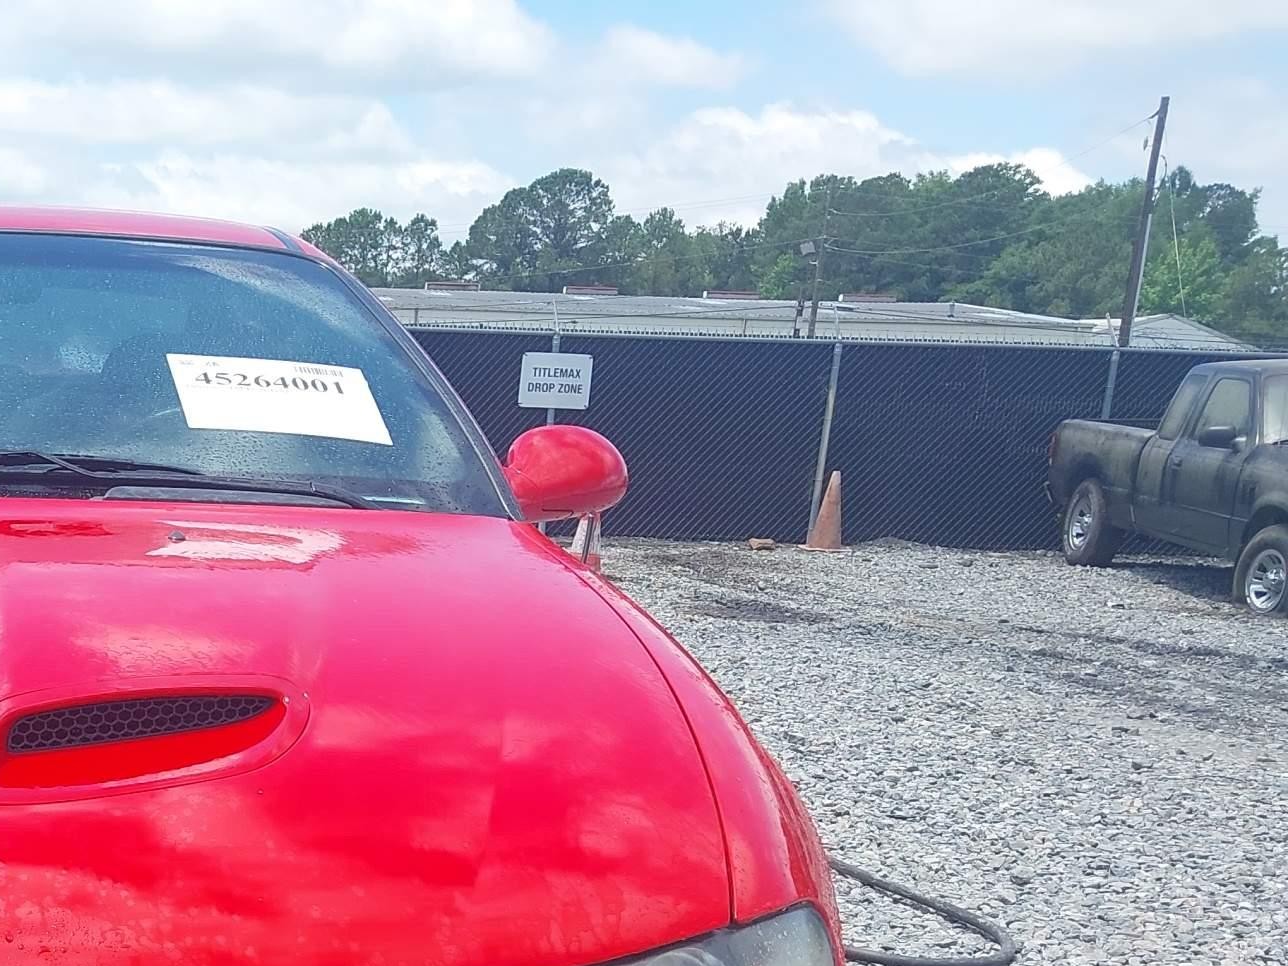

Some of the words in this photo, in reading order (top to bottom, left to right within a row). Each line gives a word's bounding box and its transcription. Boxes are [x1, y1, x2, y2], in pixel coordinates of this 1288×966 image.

[533, 367, 581, 379] TITLEMAX
[195, 371, 344, 395] 45264001
[527, 382, 555, 393] DROP
[557, 383, 583, 394] ZONE
